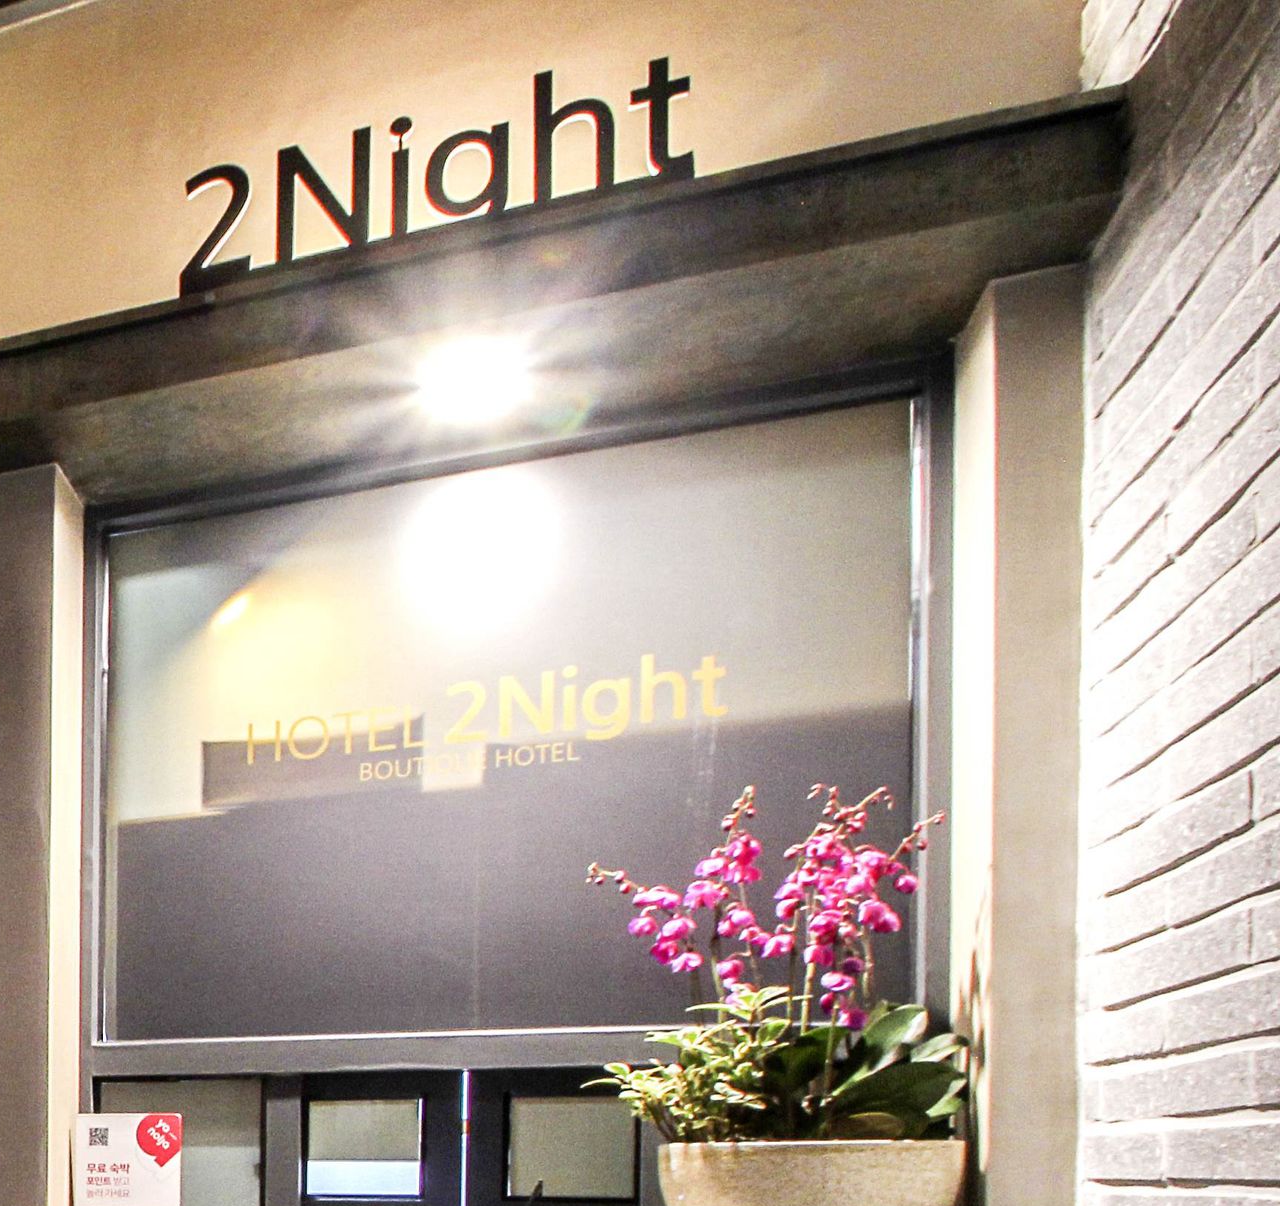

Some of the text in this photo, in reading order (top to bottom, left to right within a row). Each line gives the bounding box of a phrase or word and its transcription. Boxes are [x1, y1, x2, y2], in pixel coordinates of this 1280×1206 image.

[179, 56, 696, 299] 2Night
[246, 653, 729, 766] HOTEL 2Night
[359, 741, 581, 782] BOUTIQUE HOTEL
[86, 1163, 130, 1174] 무료 숙박
[86, 1176, 111, 1186] 포인트
